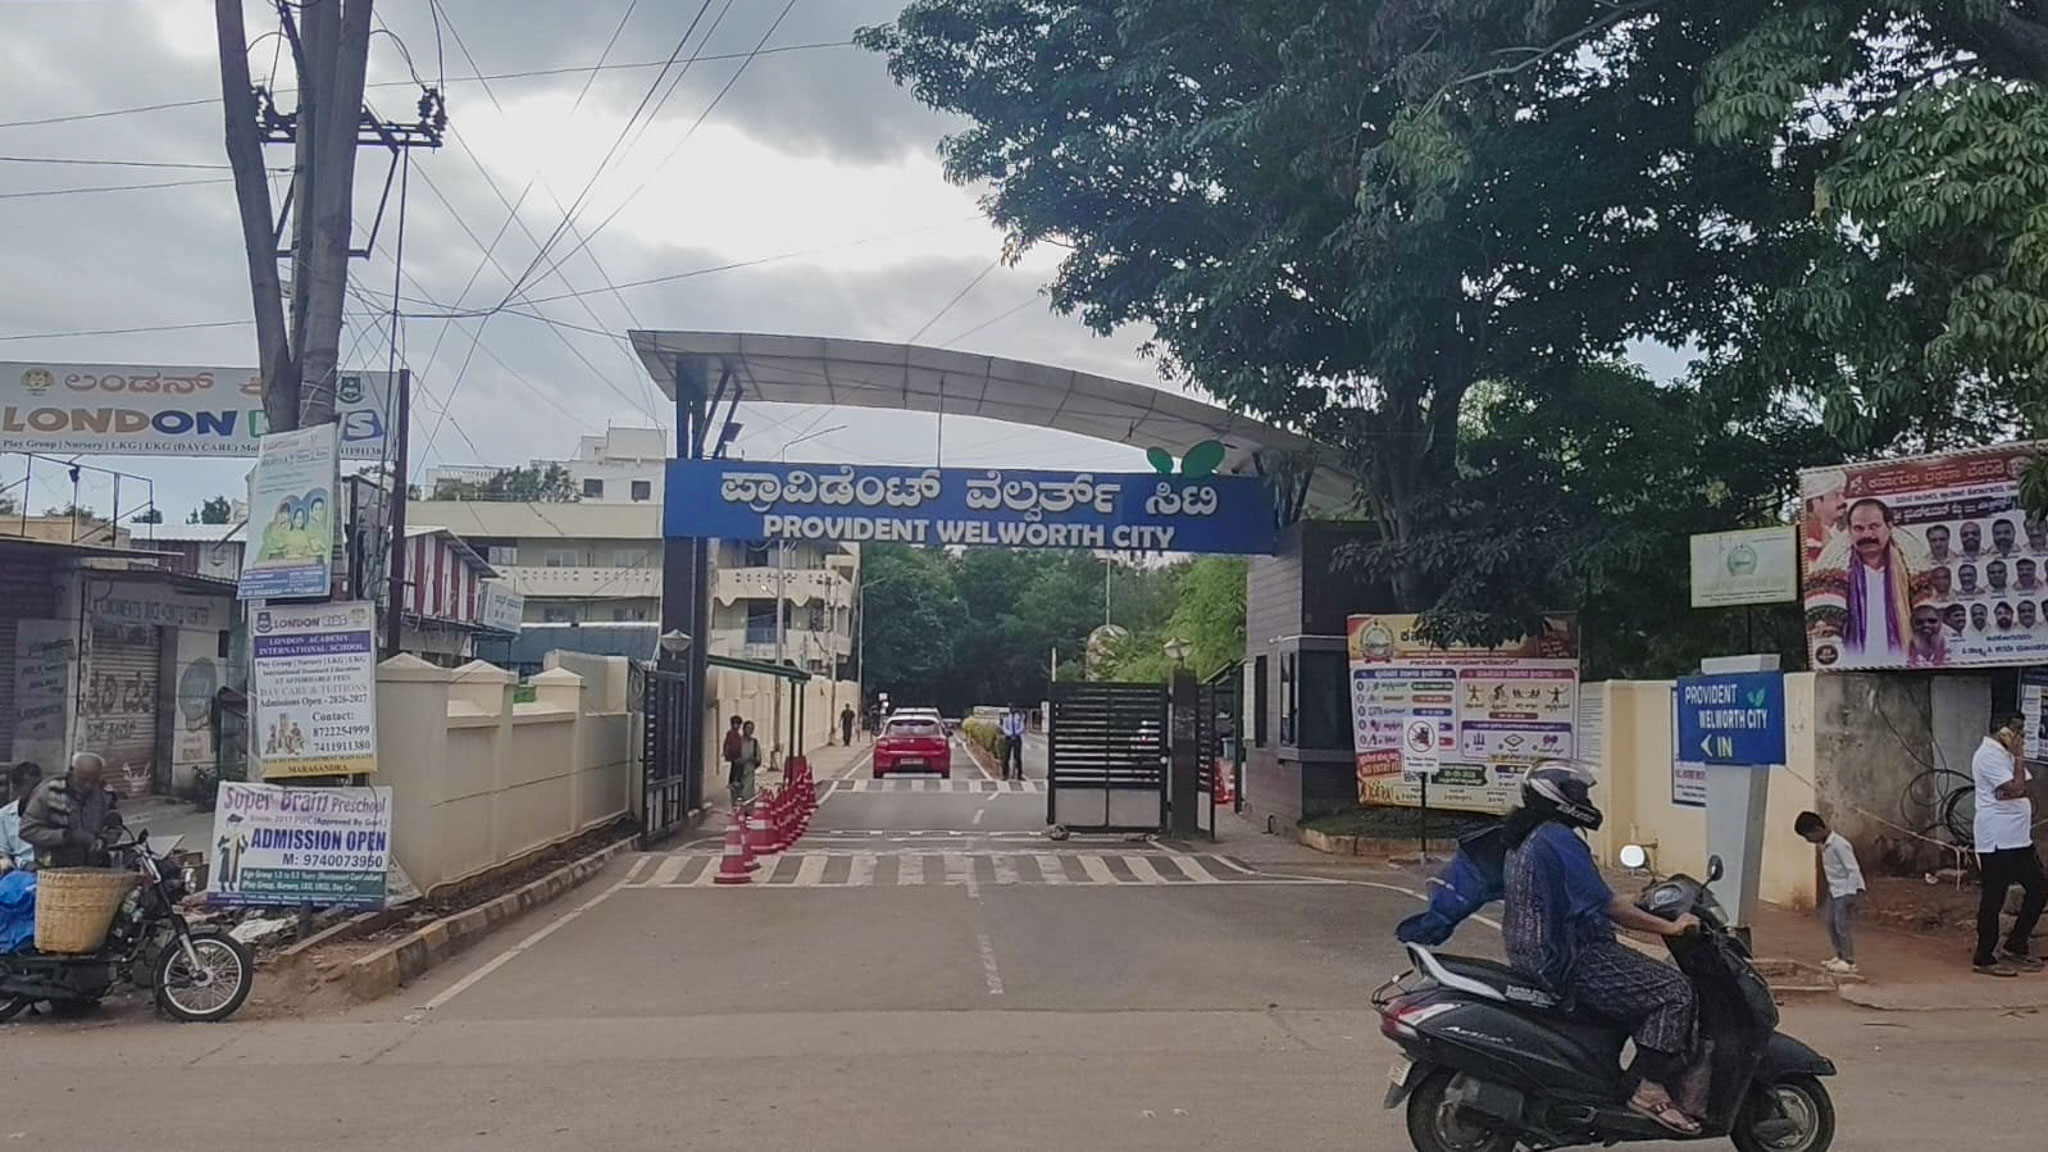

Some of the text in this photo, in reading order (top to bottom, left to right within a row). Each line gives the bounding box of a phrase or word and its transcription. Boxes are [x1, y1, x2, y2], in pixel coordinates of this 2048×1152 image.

[64, 372, 214, 395] ಲಂಡನ್
[2, 405, 238, 437] LONDON
[3, 439, 24, 450] Play
[26, 439, 57, 450] Group
[64, 440, 101, 450] Nursery
[720, 466, 941, 513] ಪ್ರಾವಿಡೆಂಟ್
[1144, 482, 1218, 515] ಸಿಟಿ
[763, 514, 1175, 550] PROVIDENT WELWORTH CITY
[273, 617, 320, 629] LONDON
[258, 645, 325, 655] INTERNATIONAL
[268, 634, 348, 646] LONDON ACADEMY
[1684, 683, 1738, 705] PROVIDENT
[1698, 708, 1769, 729] WELWORTH CITY
[1717, 735, 1733, 757] IN
[223, 787, 386, 814] Super Brain Preschool
[251, 828, 387, 851] ADMISSION OPEN
[282, 853, 299, 865] M:
